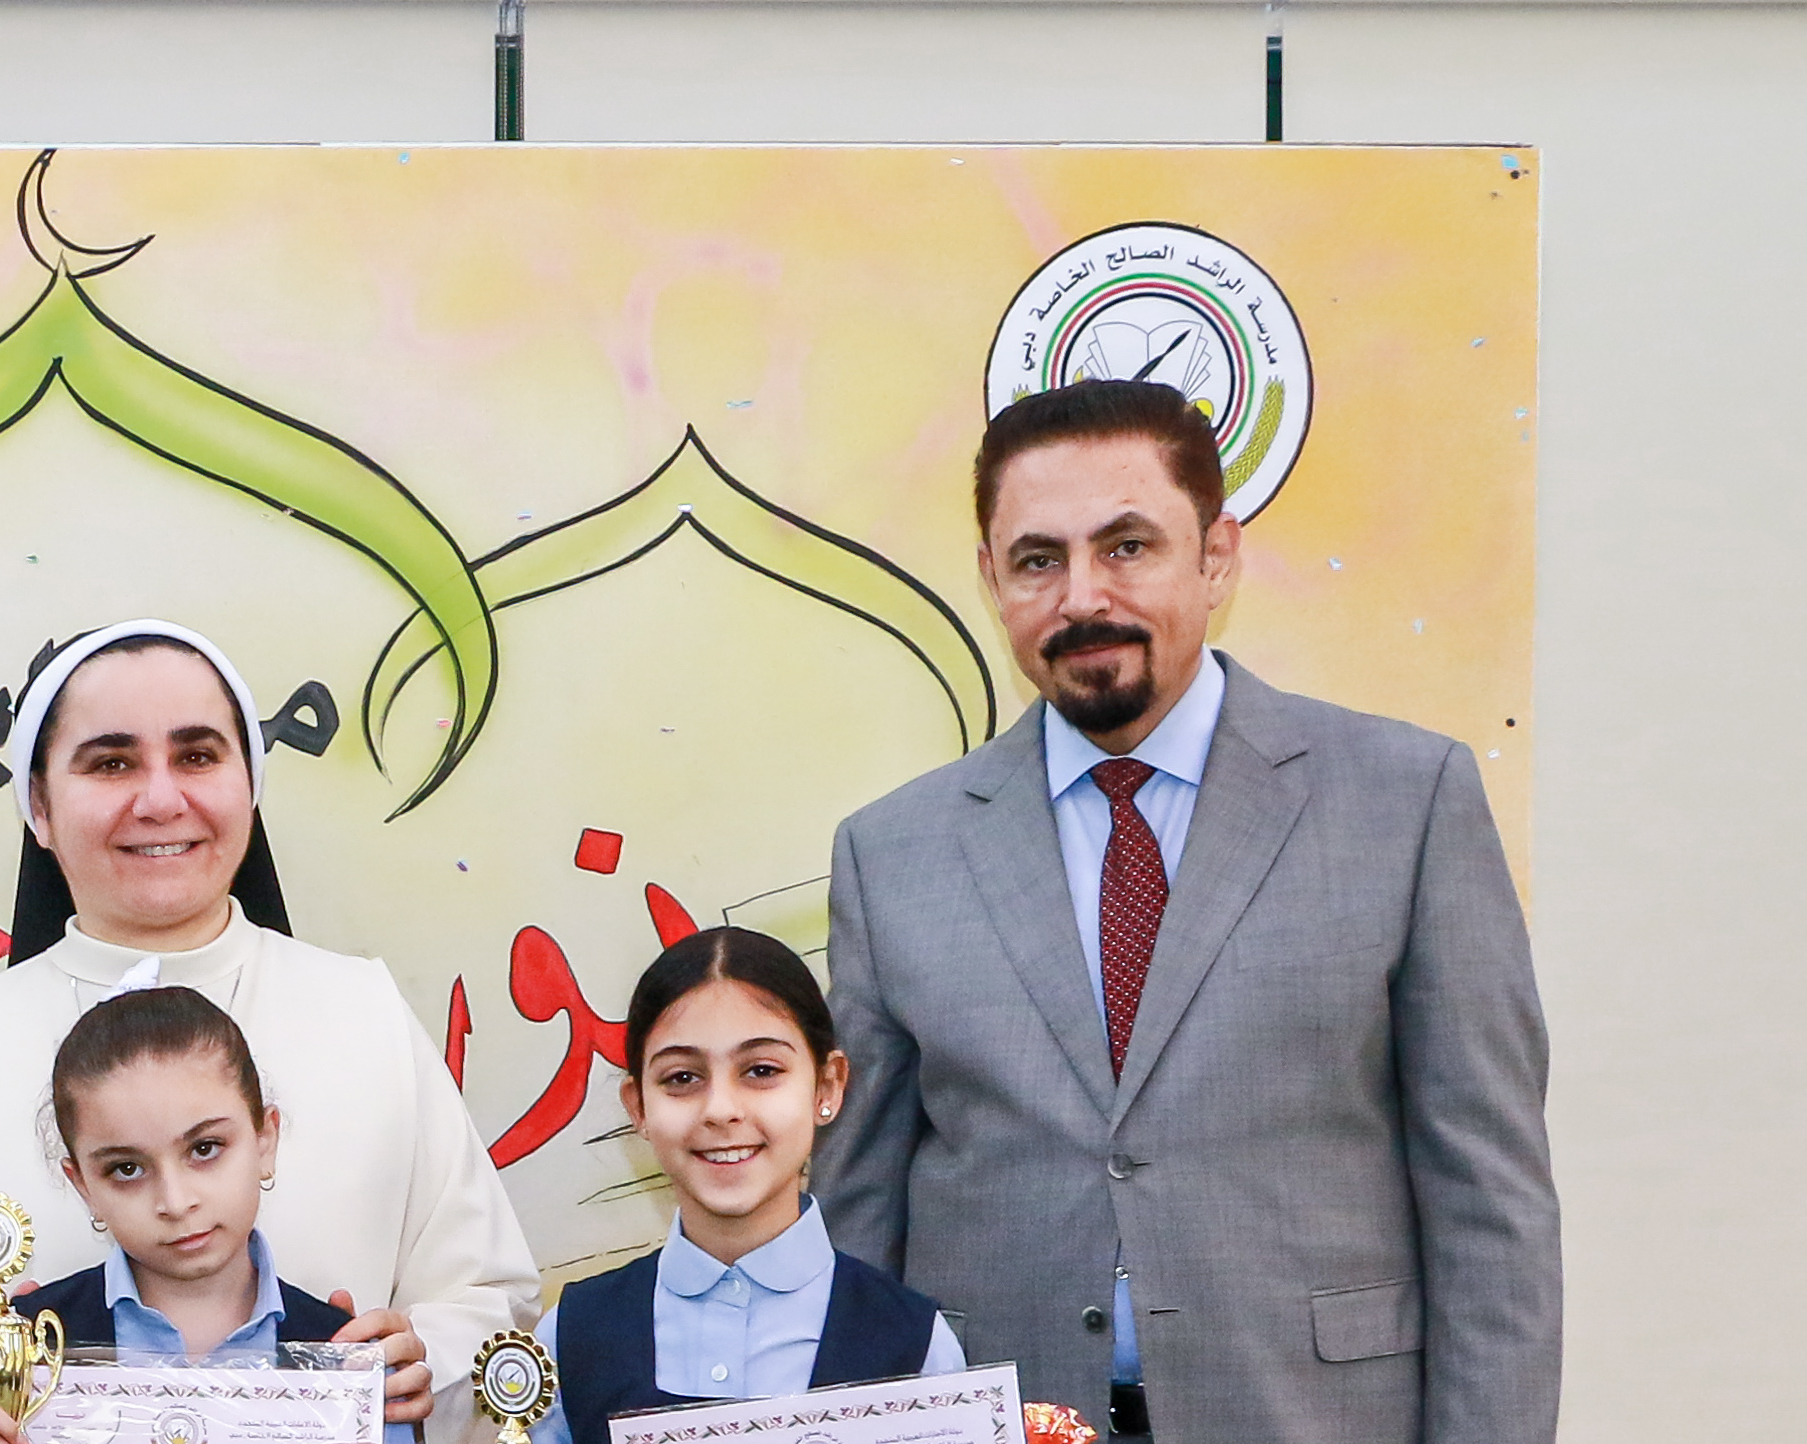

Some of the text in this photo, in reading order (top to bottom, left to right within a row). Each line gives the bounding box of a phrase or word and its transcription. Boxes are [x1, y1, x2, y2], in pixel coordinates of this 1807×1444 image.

[1020, 245, 1278, 372] مدرسة الراشد الصالح الخاصة دبي
